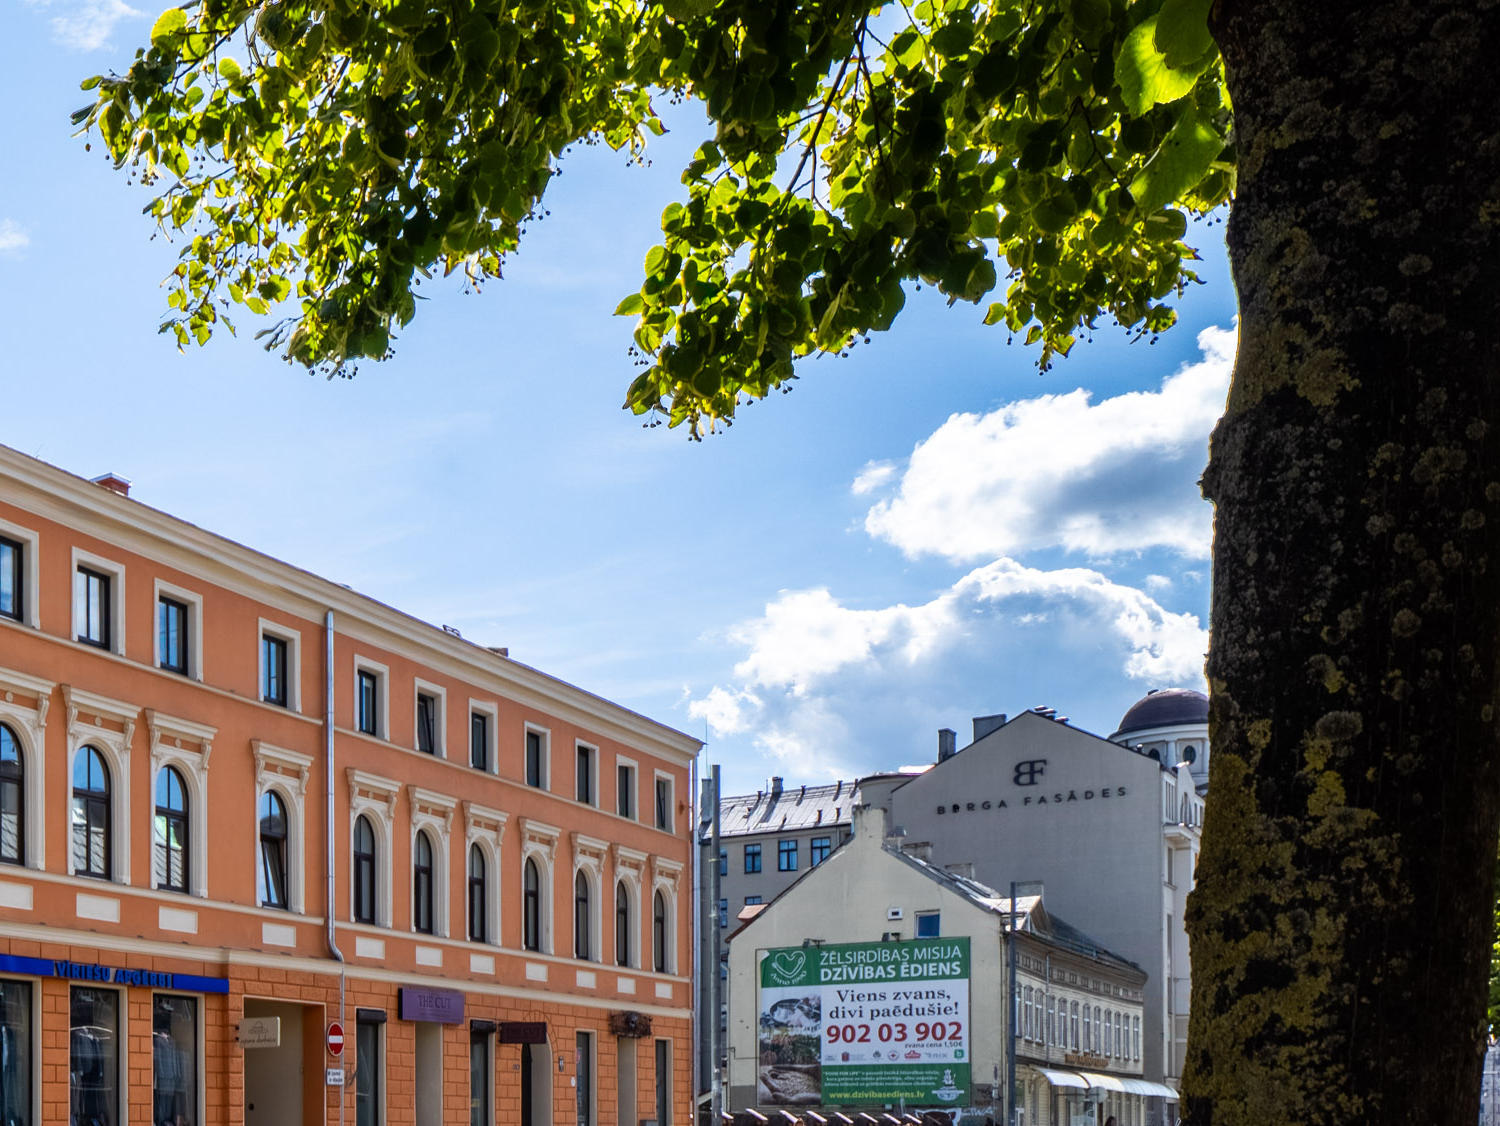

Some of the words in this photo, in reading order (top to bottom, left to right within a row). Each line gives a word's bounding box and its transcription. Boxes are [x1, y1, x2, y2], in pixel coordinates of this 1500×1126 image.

[1023, 786, 1127, 807] FASĀDES
[819, 947, 910, 966] ŽĒLSIRDĪBAS
[913, 945, 962, 961] MISIJA
[55, 960, 110, 983] VĪRIEŠU
[820, 964, 896, 982] DZĪVĪBAS
[900, 960, 961, 978] ĒDIENS
[417, 994, 434, 1009] THE
[434, 996, 452, 1010] CUT
[836, 989, 887, 1004] Viens
[892, 988, 951, 1002] zvans,
[829, 1004, 868, 1020] divi
[870, 1002, 960, 1021] paēdušie!
[826, 1024, 871, 1044] 902
[877, 1023, 908, 1042] 03
[915, 1021, 963, 1042] 902
[944, 1041, 963, 1049] 1,50€
[829, 1090, 925, 1099] www.dzivibasediens.lv
